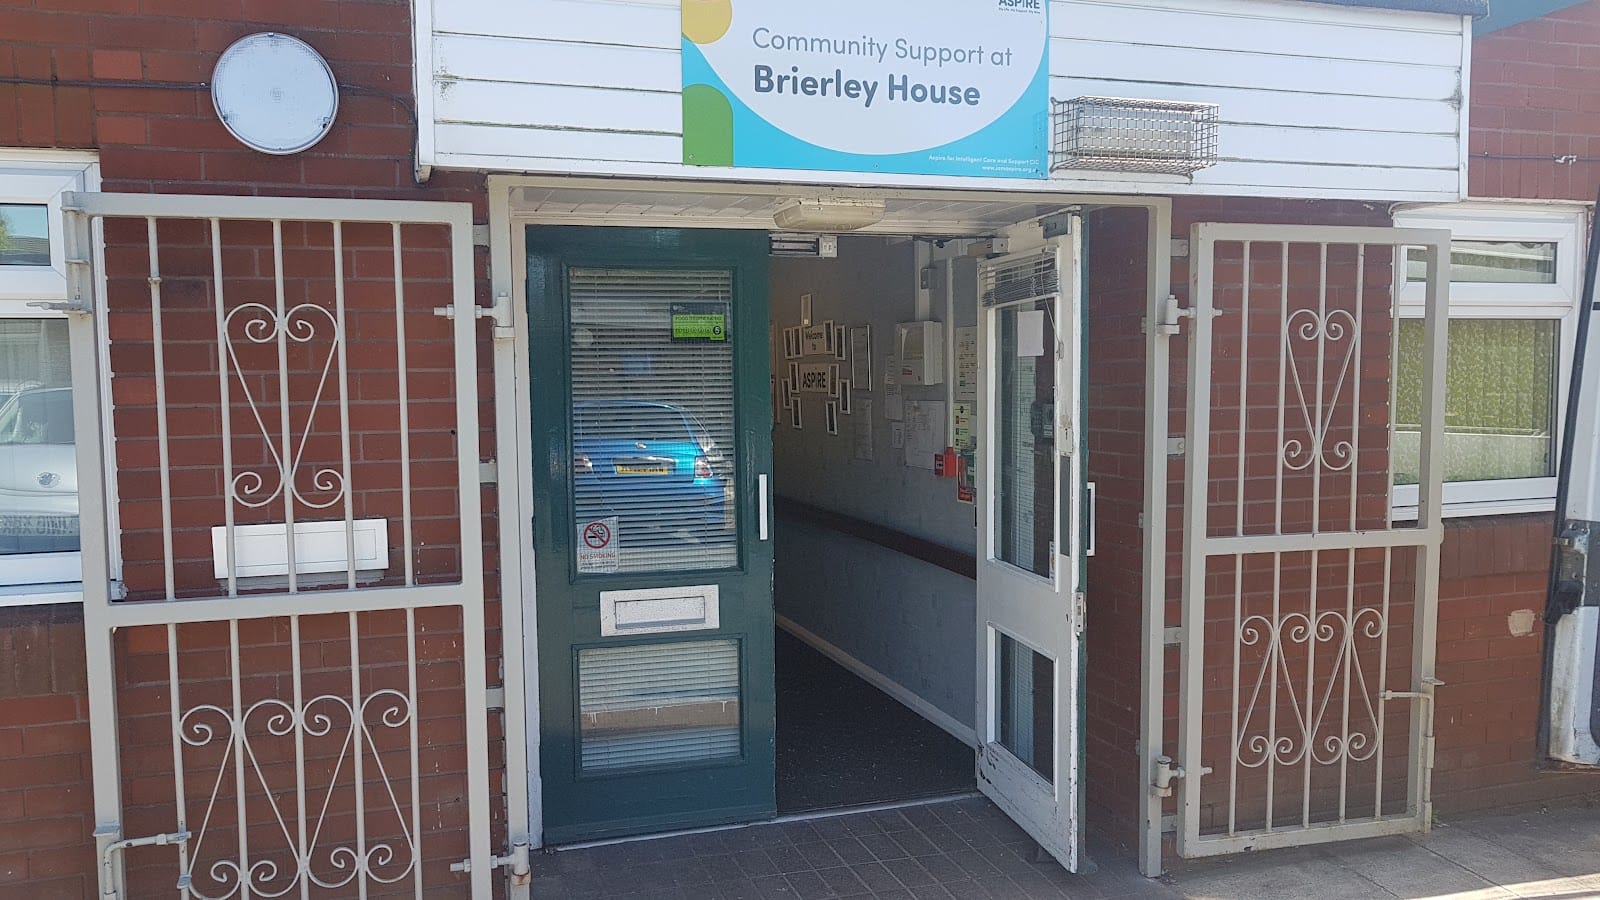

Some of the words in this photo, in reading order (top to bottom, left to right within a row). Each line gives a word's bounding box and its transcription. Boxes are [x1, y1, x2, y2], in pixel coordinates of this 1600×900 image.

[998, 0, 1040, 9] ASPIRE
[752, 27, 888, 64] Community
[895, 38, 984, 68] Support
[991, 48, 1013, 67] at
[754, 64, 879, 108] Brierley
[888, 74, 981, 106] House
[928, 154, 946, 162] Aspire
[802, 371, 826, 389] ASPIRE
